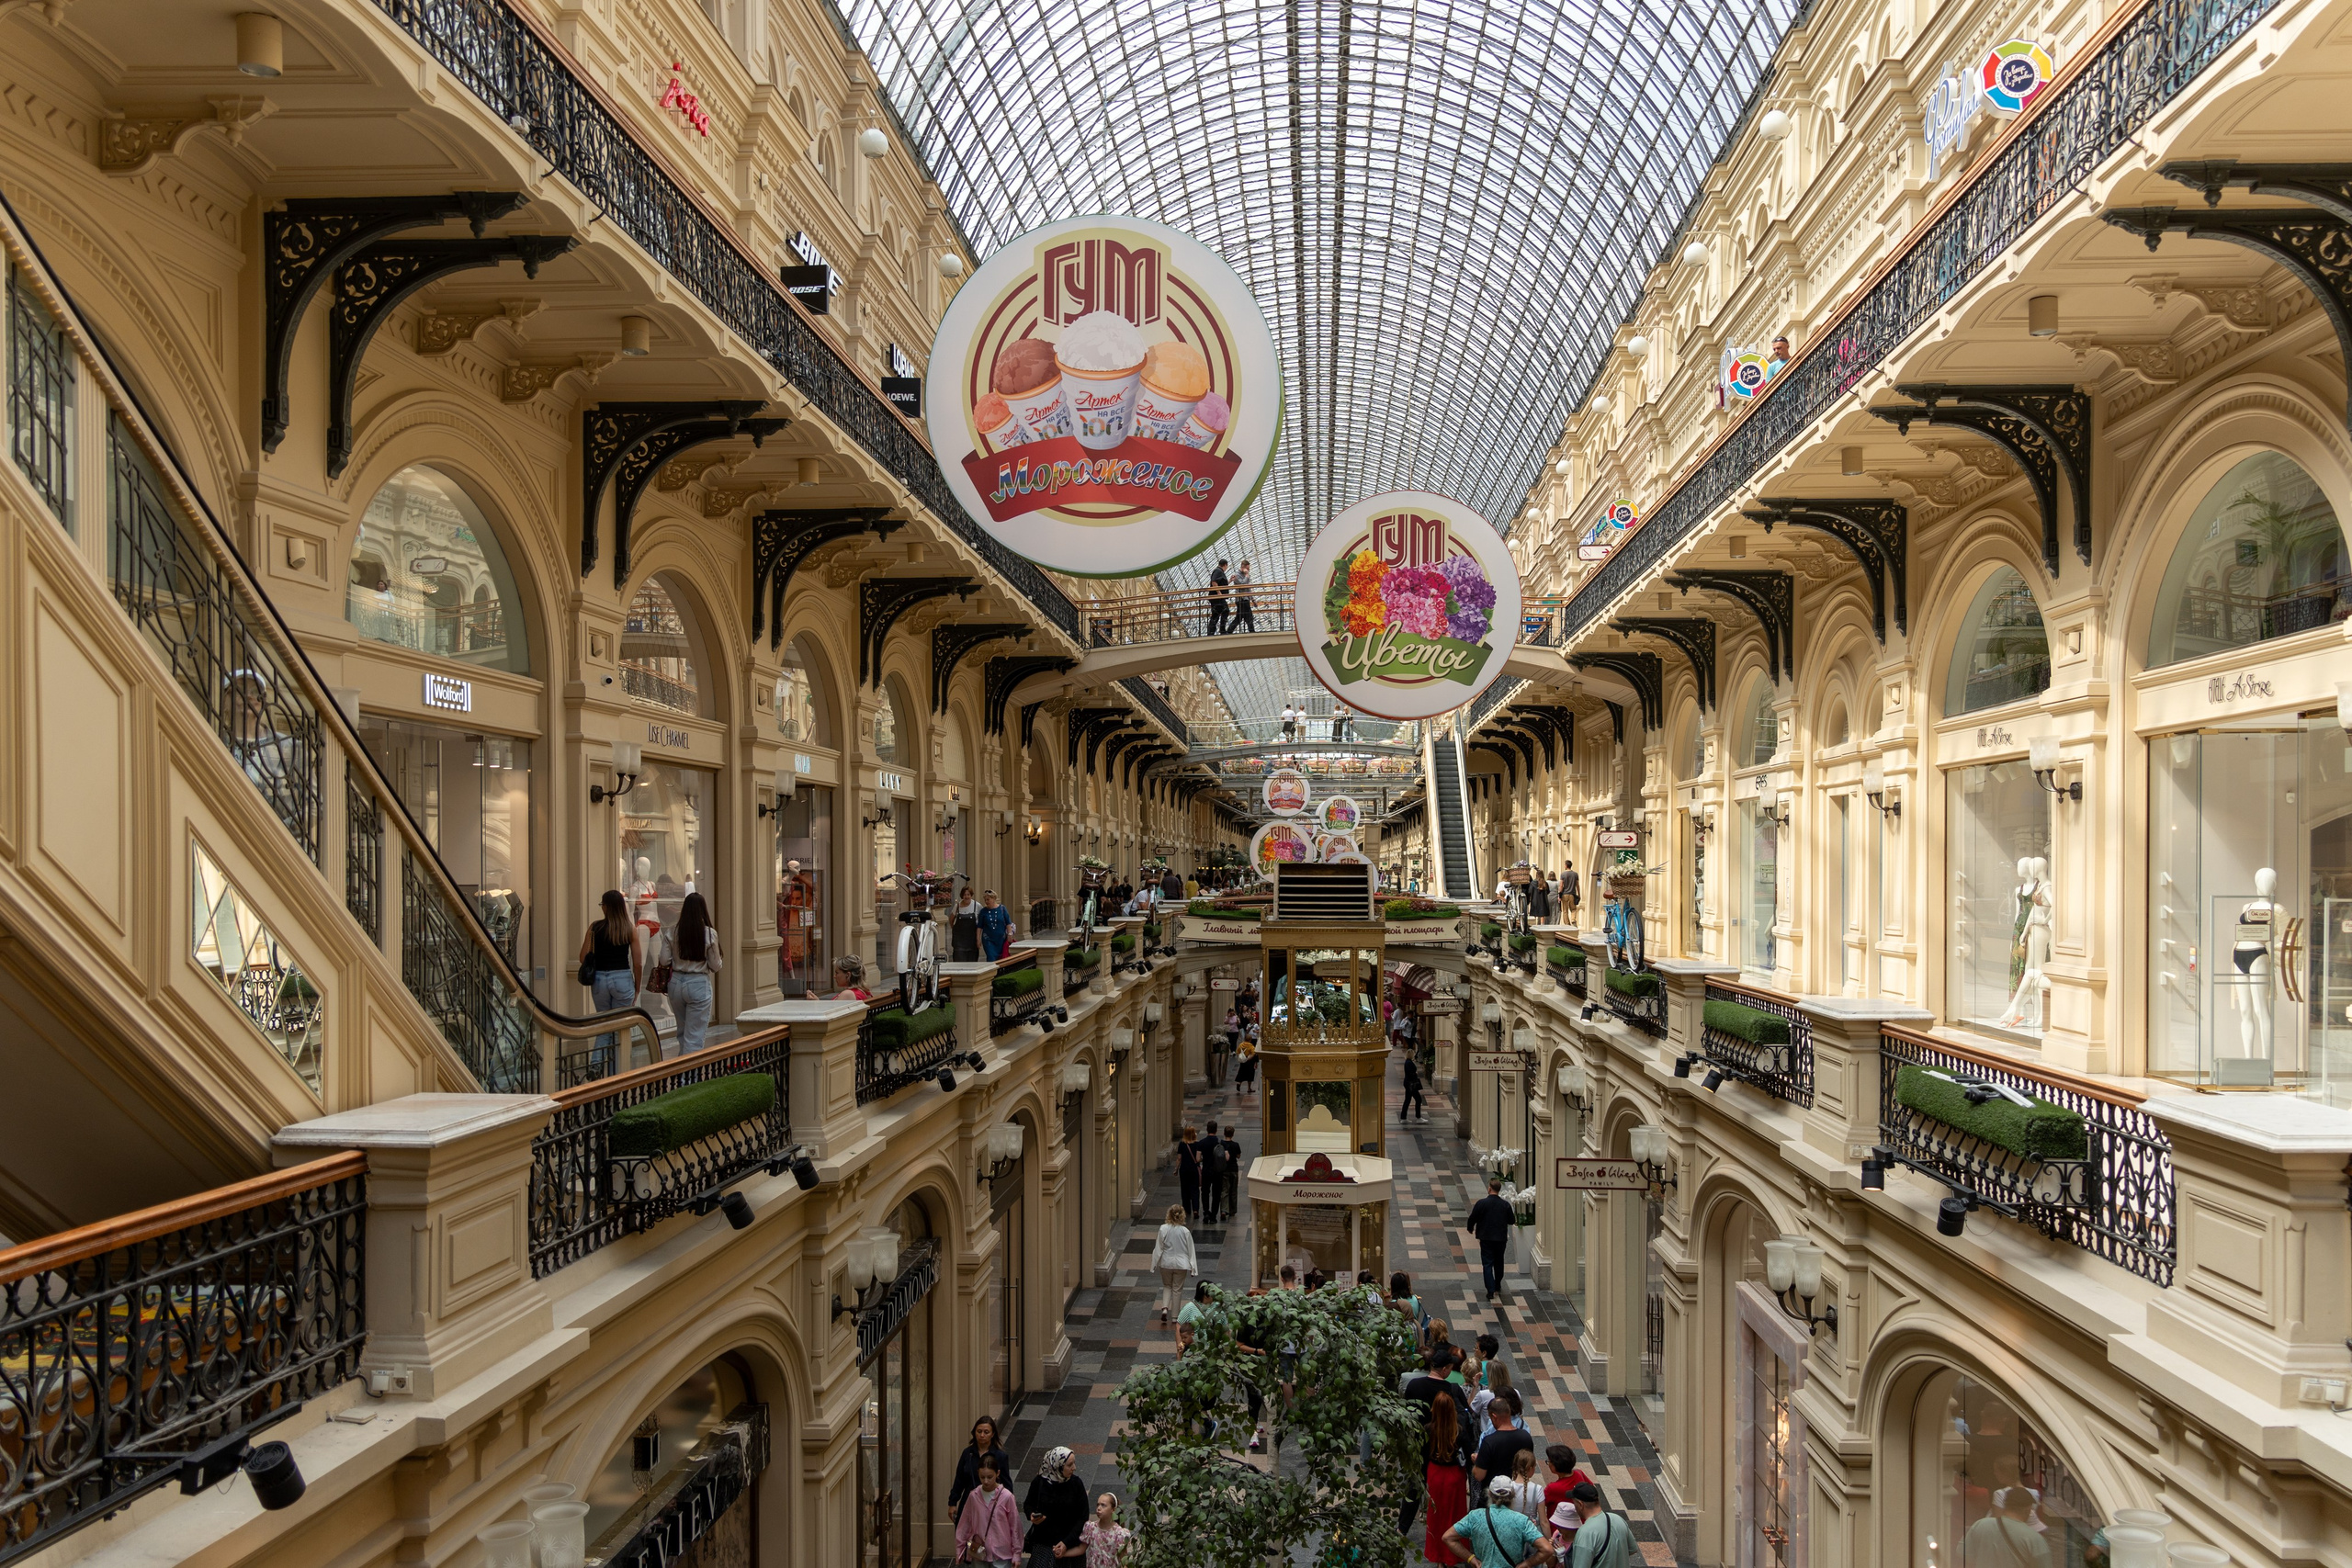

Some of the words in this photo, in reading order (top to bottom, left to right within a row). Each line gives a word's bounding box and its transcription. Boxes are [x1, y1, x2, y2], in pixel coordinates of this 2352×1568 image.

[786, 231, 843, 297] BOE
[789, 286, 825, 294] BOSE
[1043, 239, 1161, 327] ГУМ
[1024, 391, 1063, 421] Артек
[1075, 387, 1129, 407] Артек
[1111, 406, 1125, 416] ВСЕ
[1136, 400, 1183, 421] Артек
[989, 457, 1214, 503] Мороженое
[1373, 514, 1445, 569] ГУМ
[1340, 621, 1475, 680] Цветы
[434, 682, 464, 704] Wolford
[648, 722, 660, 744] LISE
[661, 725, 690, 750] CHARMEL
[879, 772, 902, 791] LIVY
[1271, 826, 1291, 841] ГУМ
[800, 913, 814, 923] SLE
[1203, 922, 1243, 934] Главный
[1403, 926, 1444, 935] площади
[1566, 1165, 1594, 1179] Bosco
[1293, 1190, 1344, 1200] Мороженое
[888, 1259, 936, 1335] DIAMONDS
